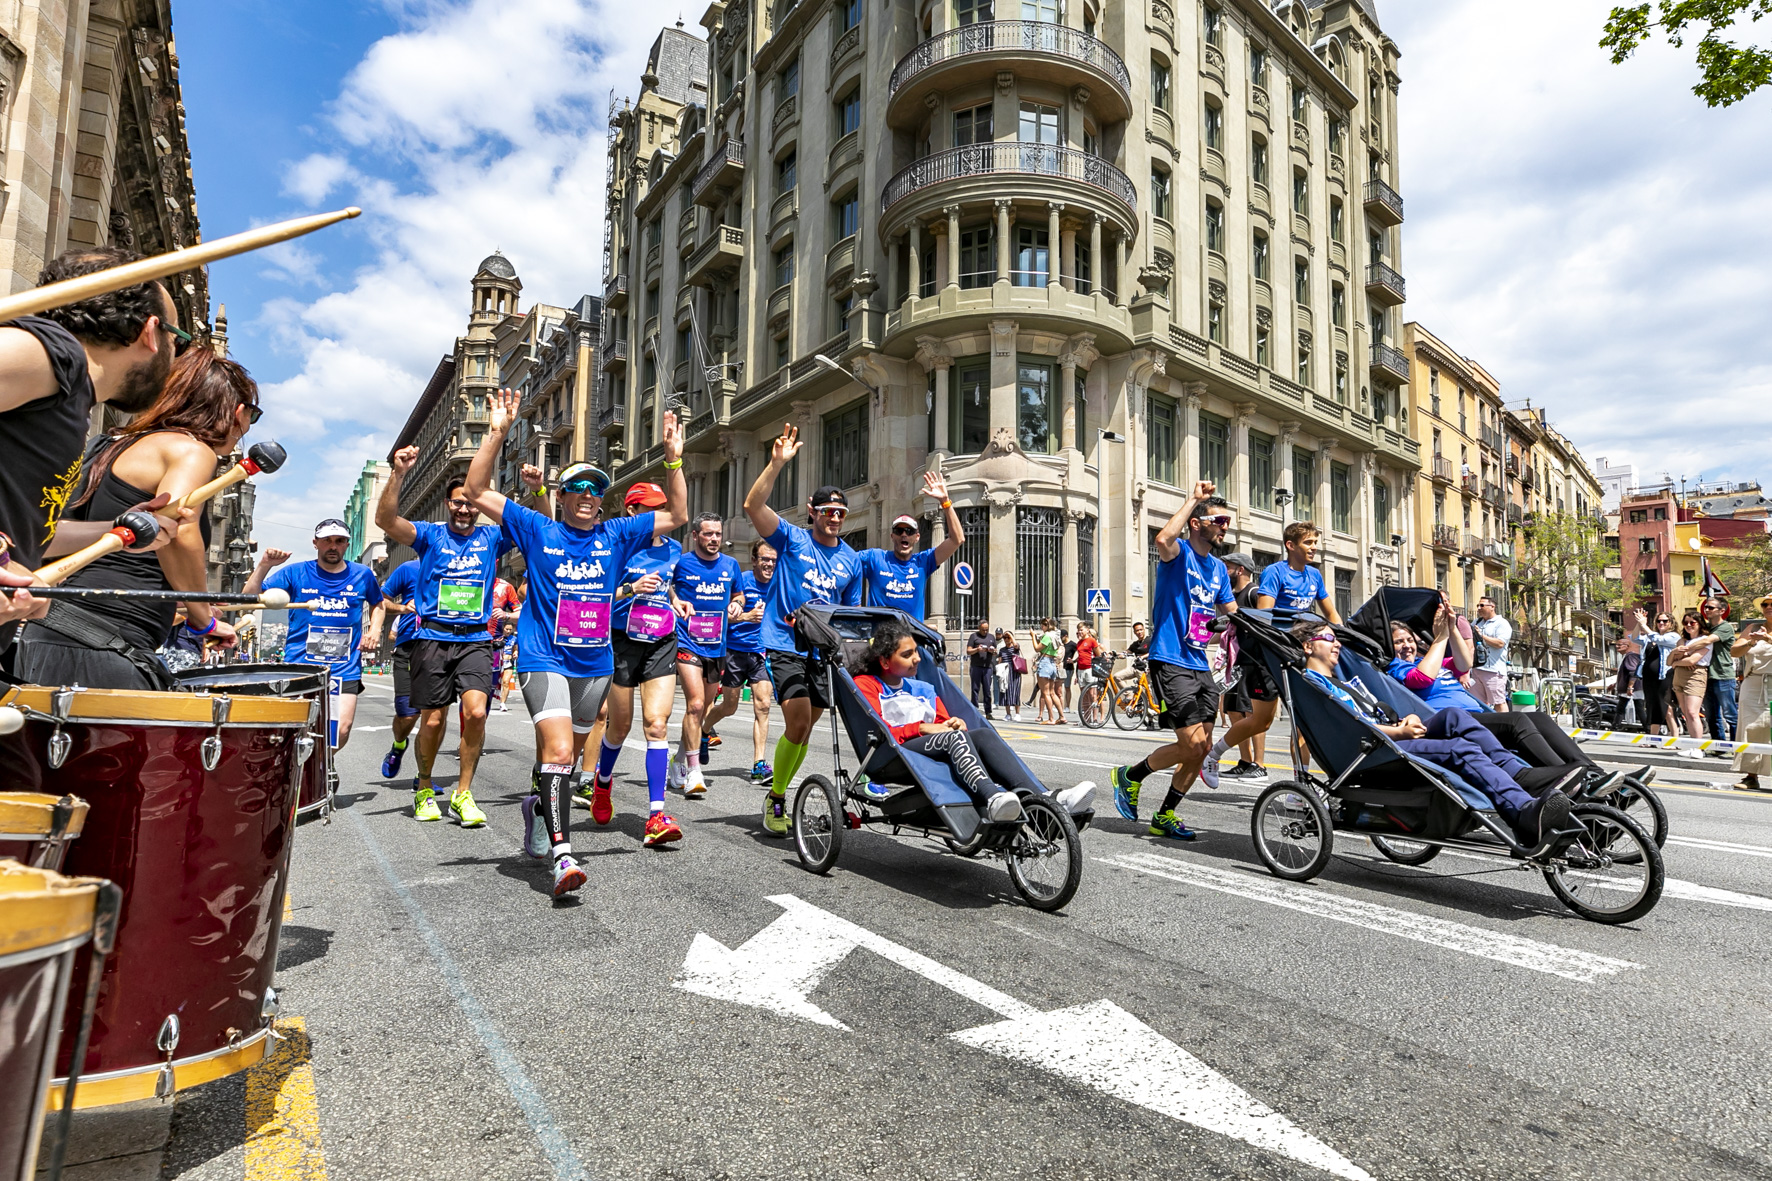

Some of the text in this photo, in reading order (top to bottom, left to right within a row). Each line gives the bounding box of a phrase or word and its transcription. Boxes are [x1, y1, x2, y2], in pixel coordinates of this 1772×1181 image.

[556, 582, 604, 591] #imparables
[580, 611, 598, 619] LAIA
[579, 621, 597, 629] 1016
[924, 730, 967, 754] JUST
[550, 774, 561, 833] COMPRESSPORT
